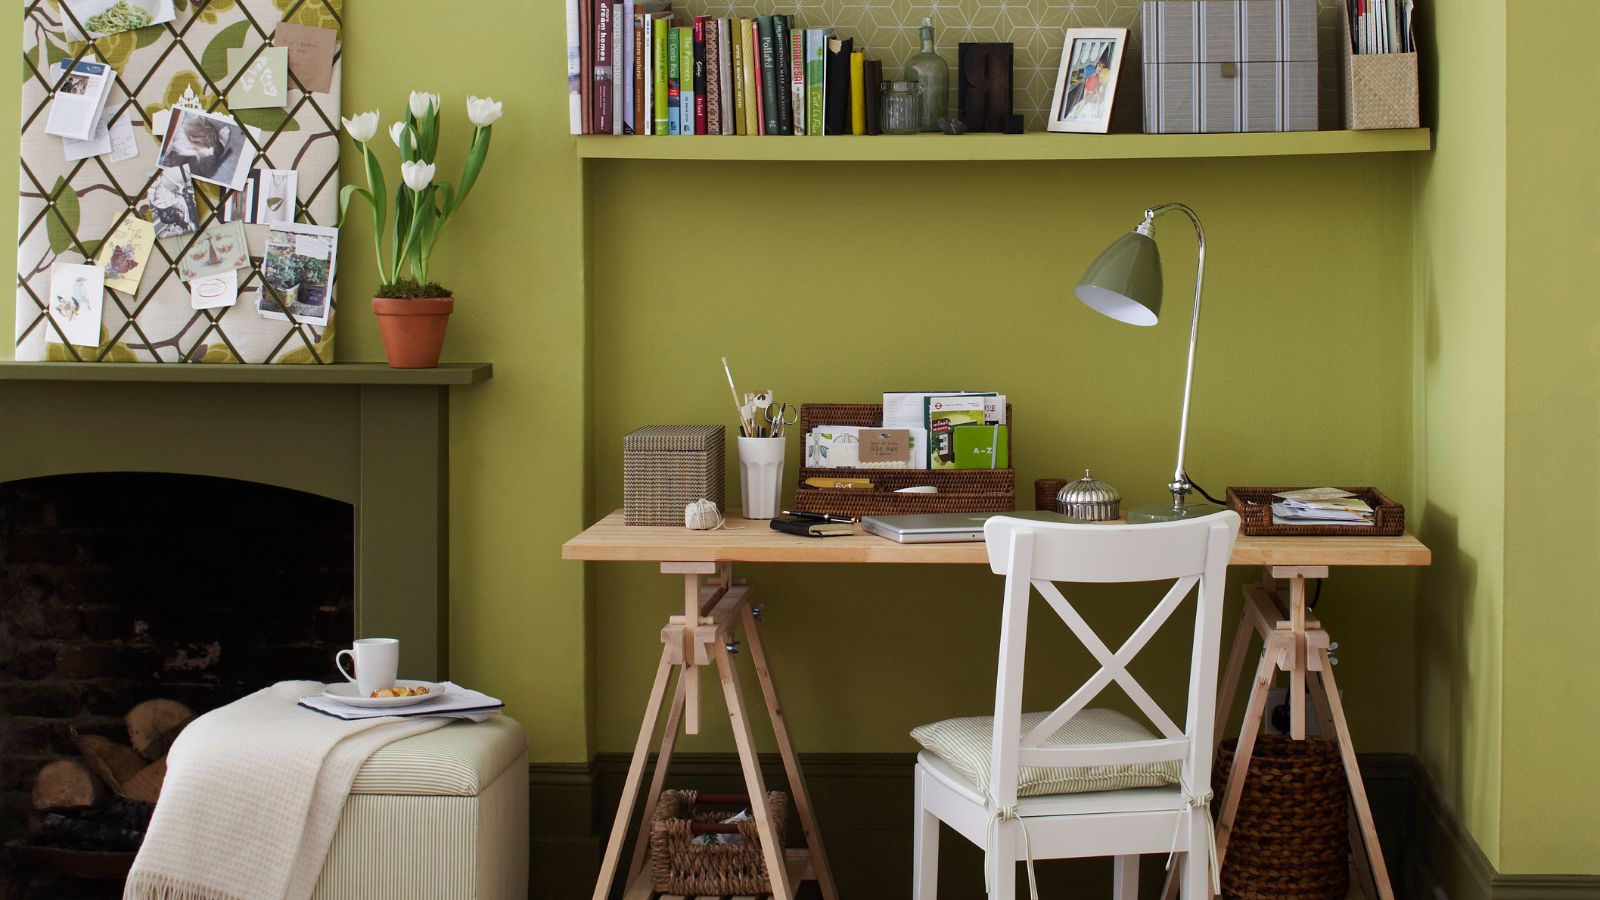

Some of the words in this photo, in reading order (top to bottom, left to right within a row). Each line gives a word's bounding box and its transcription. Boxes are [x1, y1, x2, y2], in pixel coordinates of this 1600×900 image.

[613, 11, 622, 39] room
[613, 43, 622, 85] rescues
[683, 51, 692, 82] Pyrenees
[762, 36, 774, 68] Pollard
[793, 61, 803, 85] DESAI
